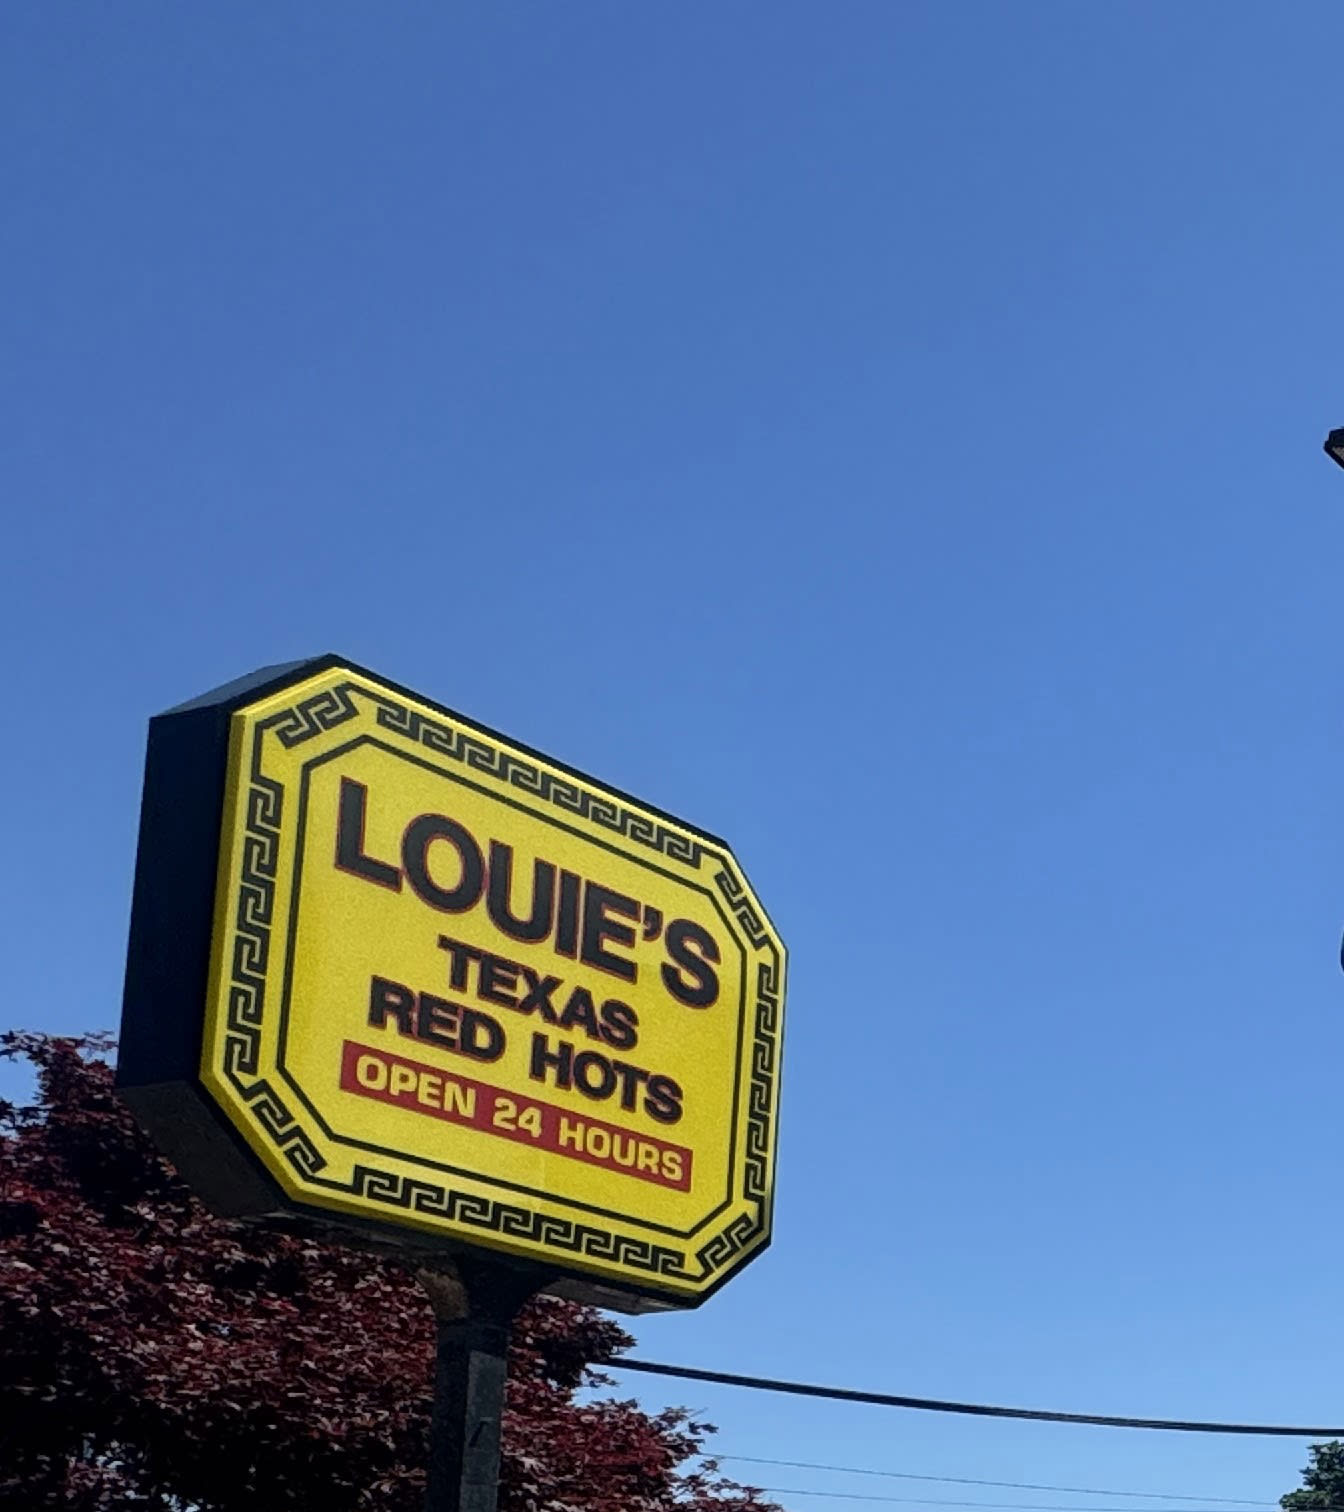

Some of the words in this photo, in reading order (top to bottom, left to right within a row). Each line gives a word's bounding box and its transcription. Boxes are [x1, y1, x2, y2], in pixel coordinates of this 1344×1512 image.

[334, 775, 722, 1010] LOUIE'S
[366, 974, 507, 1064] RED
[529, 1030, 684, 1126] HOTS
[436, 933, 640, 1051] TEXAS
[356, 1054, 478, 1119] OPEN
[493, 1096, 544, 1138] 24
[558, 1116, 685, 1182] HOURS
